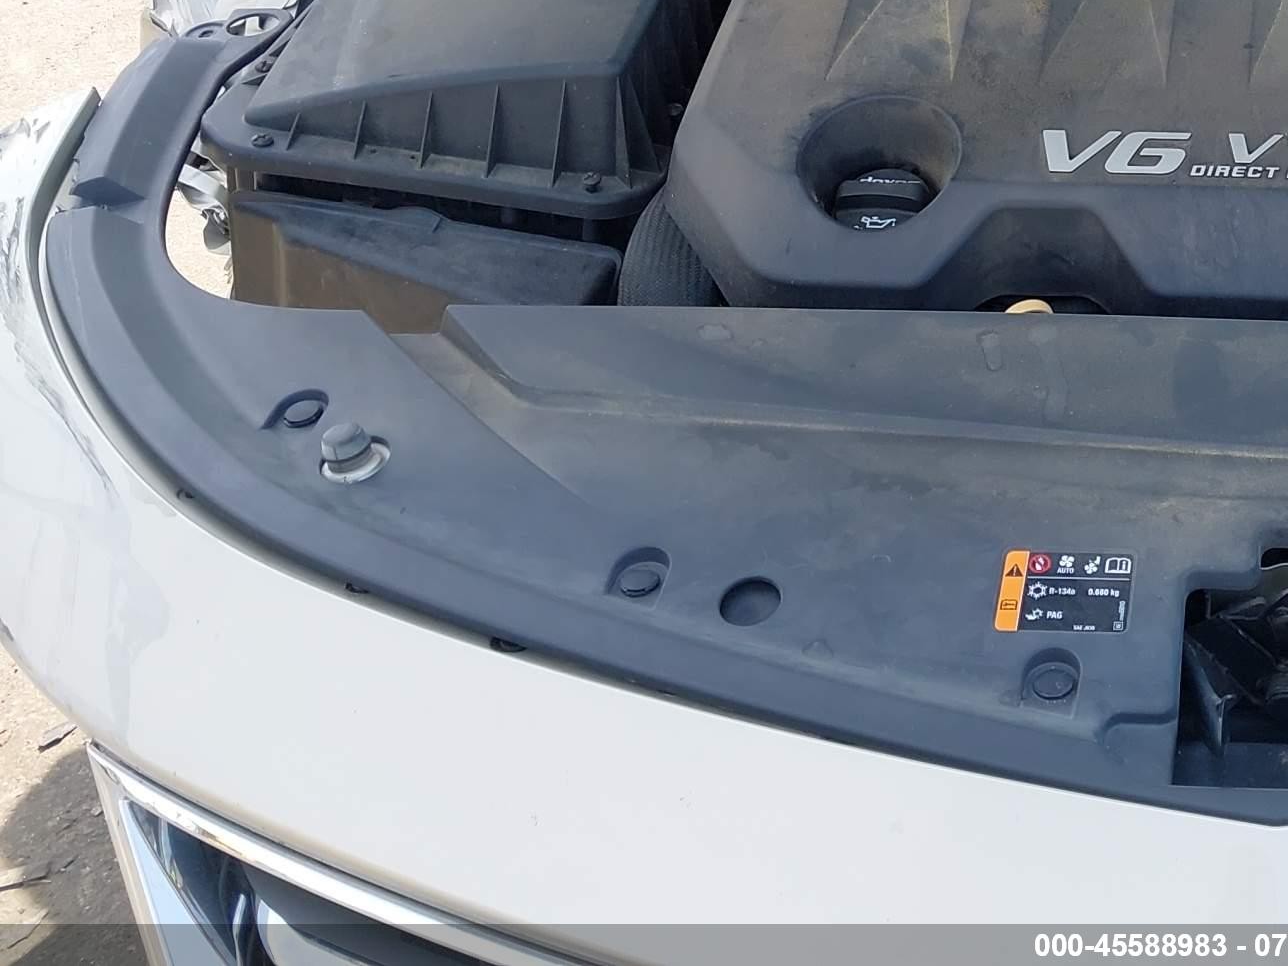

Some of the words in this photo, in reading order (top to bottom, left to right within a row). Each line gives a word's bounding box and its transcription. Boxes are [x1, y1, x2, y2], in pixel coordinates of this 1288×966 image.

[1041, 129, 1192, 174] V6
[1189, 165, 1280, 179] DIRECT
[1111, 589, 1120, 597] kg
[1046, 611, 1063, 619] PAG
